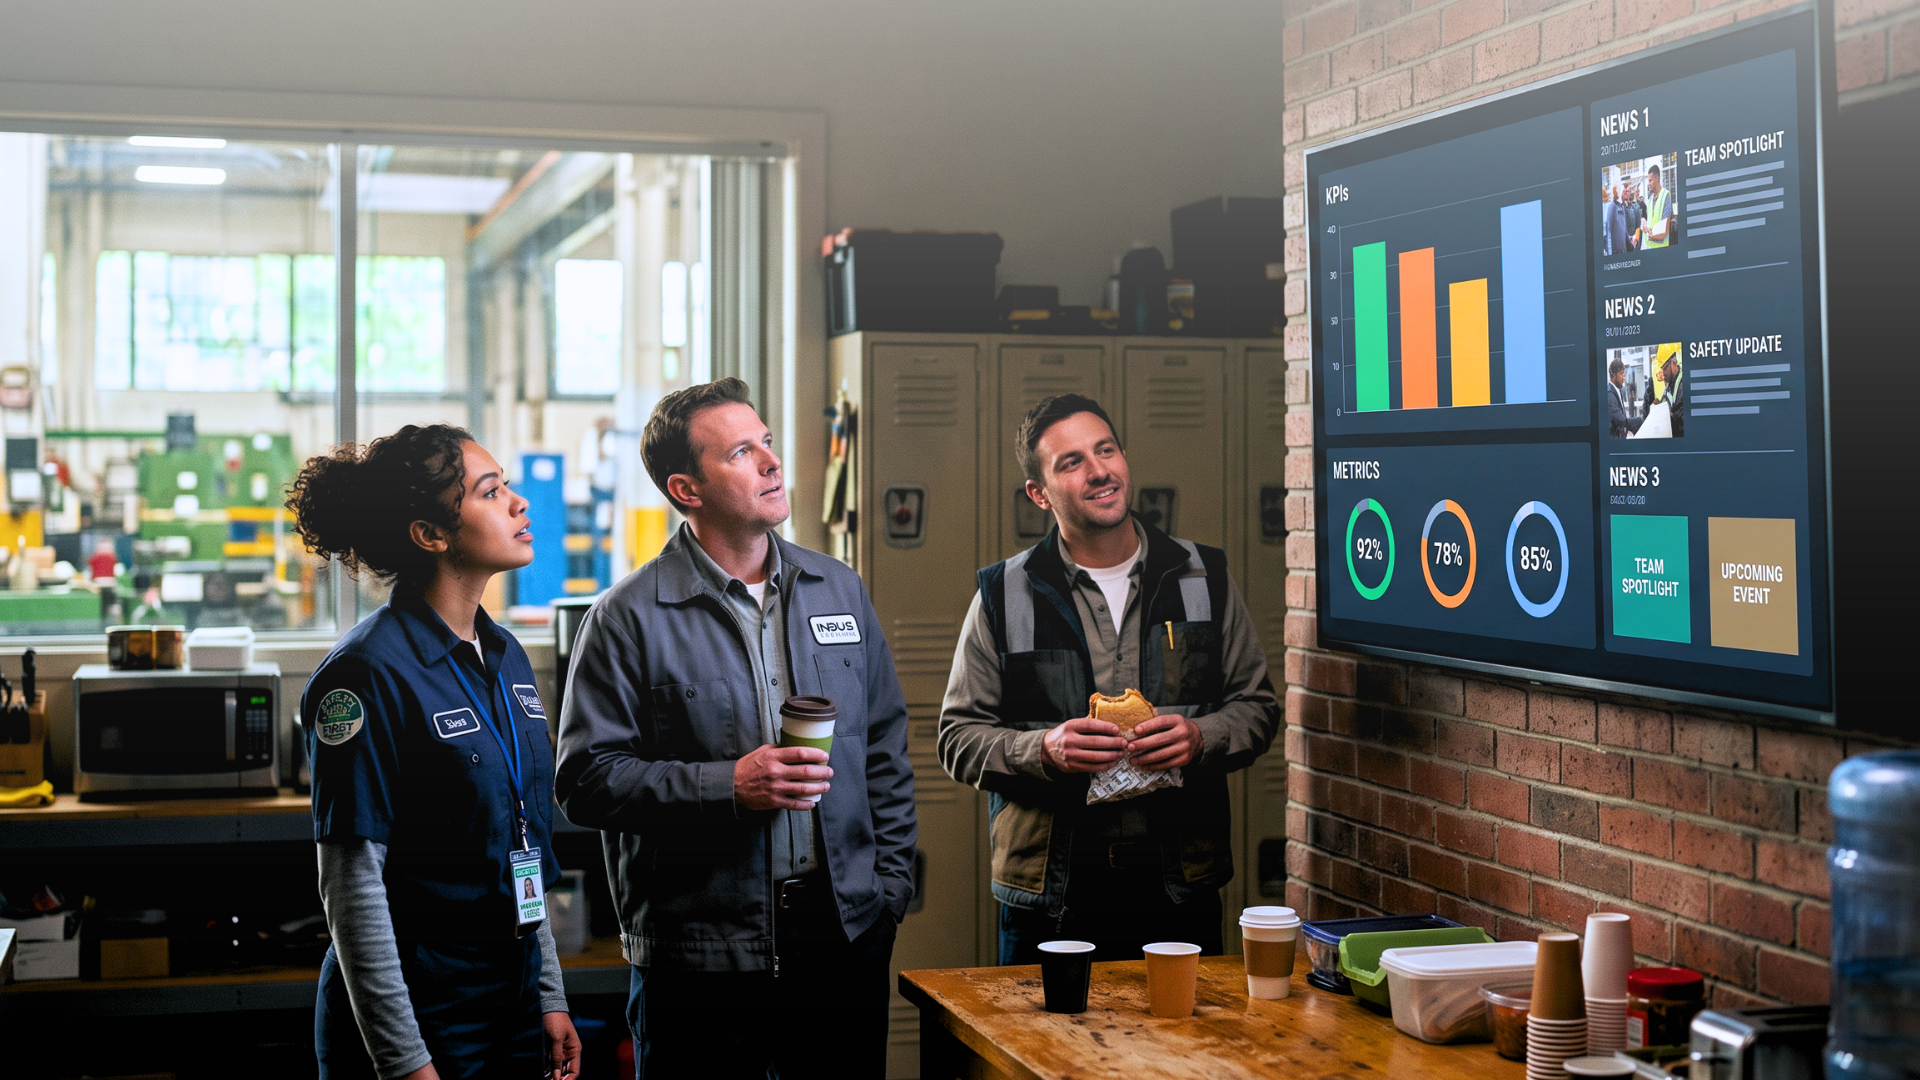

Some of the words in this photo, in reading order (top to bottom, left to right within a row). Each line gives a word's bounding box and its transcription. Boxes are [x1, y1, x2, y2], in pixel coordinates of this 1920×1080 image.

[1600, 109, 1639, 138] NEWS
[1642, 106, 1650, 128] 1
[1684, 144, 1716, 167] TEAM
[1719, 130, 1785, 161] SPOTLIGHT
[1325, 184, 1349, 206] KPIs
[1326, 224, 1336, 235] 40
[1329, 270, 1338, 280] 30
[1605, 295, 1644, 320] NEWS
[1647, 294, 1656, 315] 2
[1689, 338, 1733, 359] SAFETY
[1735, 334, 1783, 356] UPDATE
[1332, 362, 1340, 371] 10
[1335, 407, 1342, 417] 0
[1333, 460, 1381, 480] METRICS
[1609, 465, 1648, 487] NEWS
[1651, 465, 1660, 487] 3
[1356, 537, 1383, 561] 92%
[1433, 541, 1463, 567] 78%
[1520, 545, 1553, 572] 85%
[1634, 557, 1664, 575] TEAM
[1721, 562, 1783, 583] UPCOMING
[1621, 577, 1680, 598] SPOTLIGHT
[1733, 585, 1771, 605] EVENT
